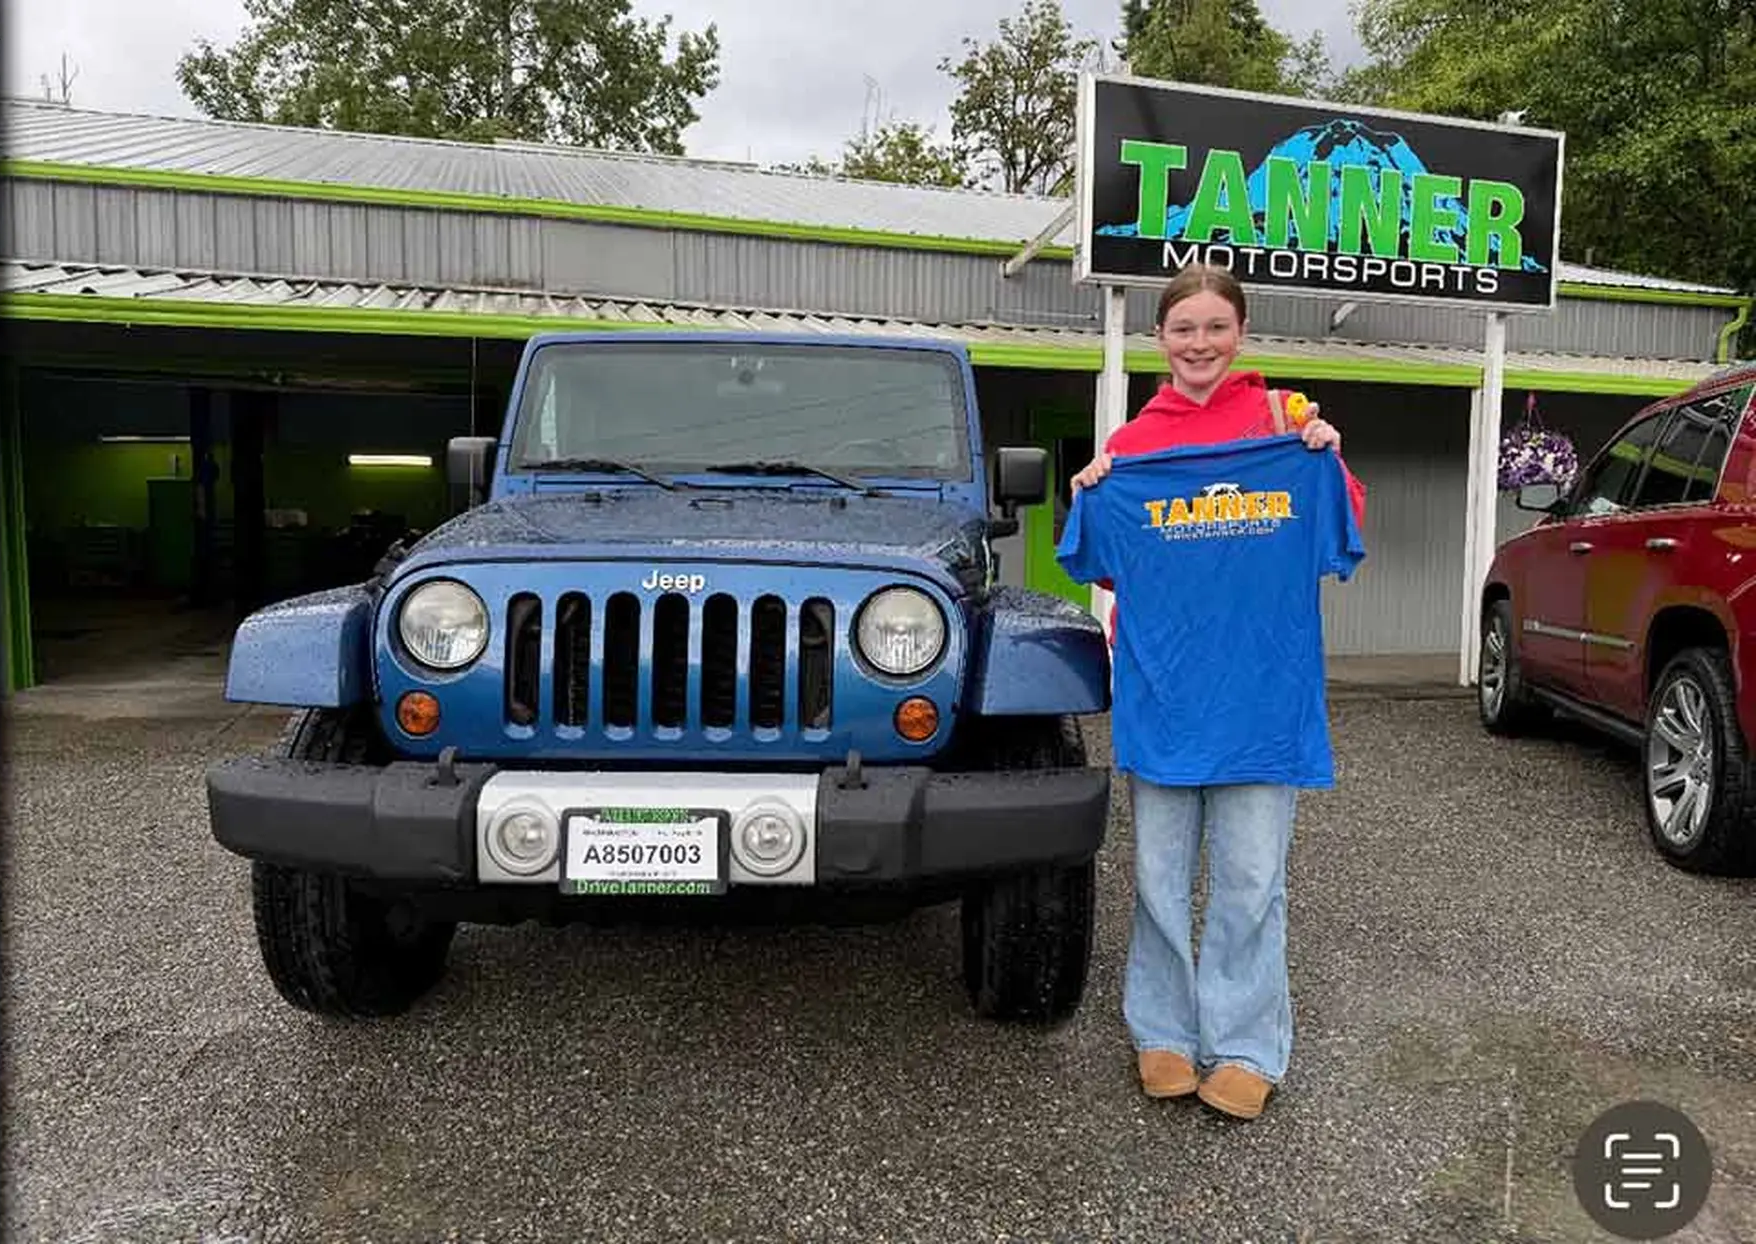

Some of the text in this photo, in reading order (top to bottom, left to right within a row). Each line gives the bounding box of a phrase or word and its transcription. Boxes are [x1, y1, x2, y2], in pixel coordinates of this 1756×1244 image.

[1120, 139, 1525, 271] TANNER
[1162, 241, 1500, 293] MOTORSPORTS
[1144, 490, 1291, 527] TANNER
[642, 569, 705, 593] Jeep
[582, 844, 702, 864] A8507003
